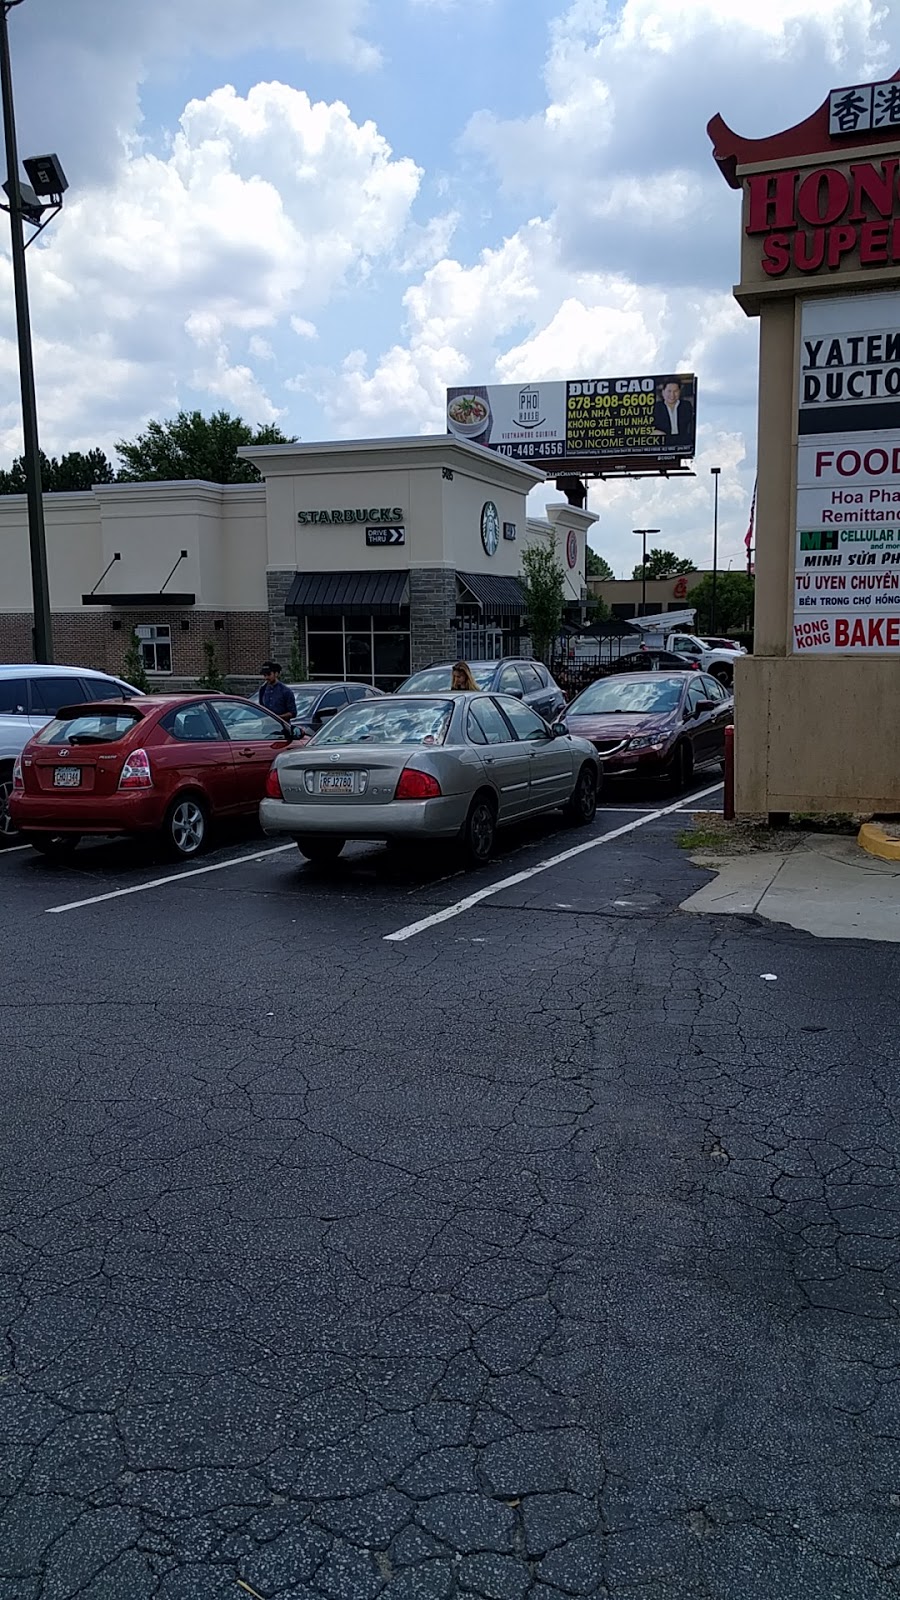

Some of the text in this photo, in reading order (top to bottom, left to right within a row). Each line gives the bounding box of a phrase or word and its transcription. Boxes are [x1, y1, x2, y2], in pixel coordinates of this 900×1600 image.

[746, 159, 900, 235] HON
[615, 378, 655, 394] CAO
[520, 394, 538, 410] PHO
[568, 393, 655, 409] 678-908-6606
[519, 411, 539, 420] HOUSE
[568, 410, 589, 419] MUA
[614, 417, 630, 426] THU
[567, 430, 586, 438] BUY
[588, 428, 615, 437] HOME
[624, 426, 656, 435] INVEST
[567, 439, 583, 449] NO
[584, 437, 624, 448] INCOME
[626, 436, 660, 446] CHECK
[496, 443, 563, 456] 470-448-4556
[831, 490, 863, 504] Hoa
[297, 507, 404, 524] STARBUCKS
[368, 529, 387, 537] DRIVE
[840, 529, 894, 542] CELLULAR
[870, 542, 884, 550] and
[804, 554, 842, 567] MINH
[795, 573, 811, 590] TÚ
[815, 575, 846, 590] UYEN
[799, 596, 817, 606] BÊN
[820, 596, 850, 606] TRONG
[794, 617, 900, 647] HONG BAKE
[796, 632, 831, 649] KONG
